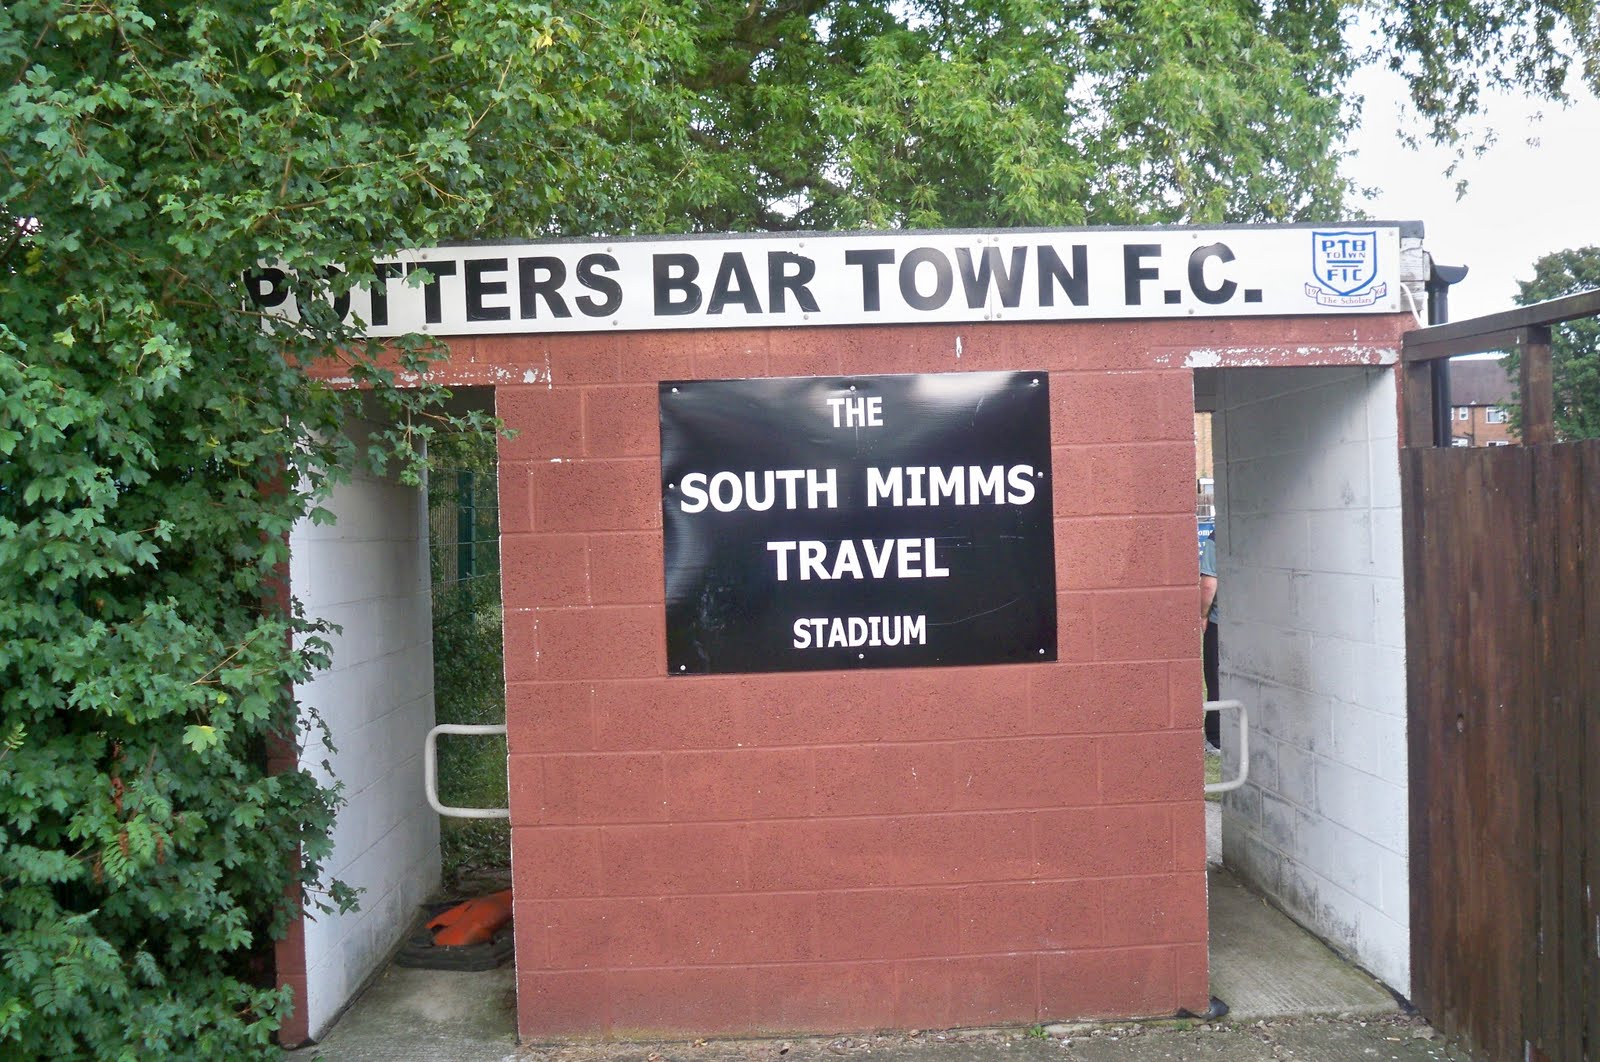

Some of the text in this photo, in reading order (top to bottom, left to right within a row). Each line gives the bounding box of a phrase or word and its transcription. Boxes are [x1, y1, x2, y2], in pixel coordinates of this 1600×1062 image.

[652, 251, 821, 316] BAR
[845, 245, 1089, 311] TOWN
[1123, 242, 1262, 305] F.C.
[1341, 297, 1372, 305] Scholars
[826, 396, 883, 428] THE
[680, 465, 1036, 513] SOUTH MIMMS
[767, 537, 949, 581] TRAVEL
[793, 615, 926, 648] STADIUM
